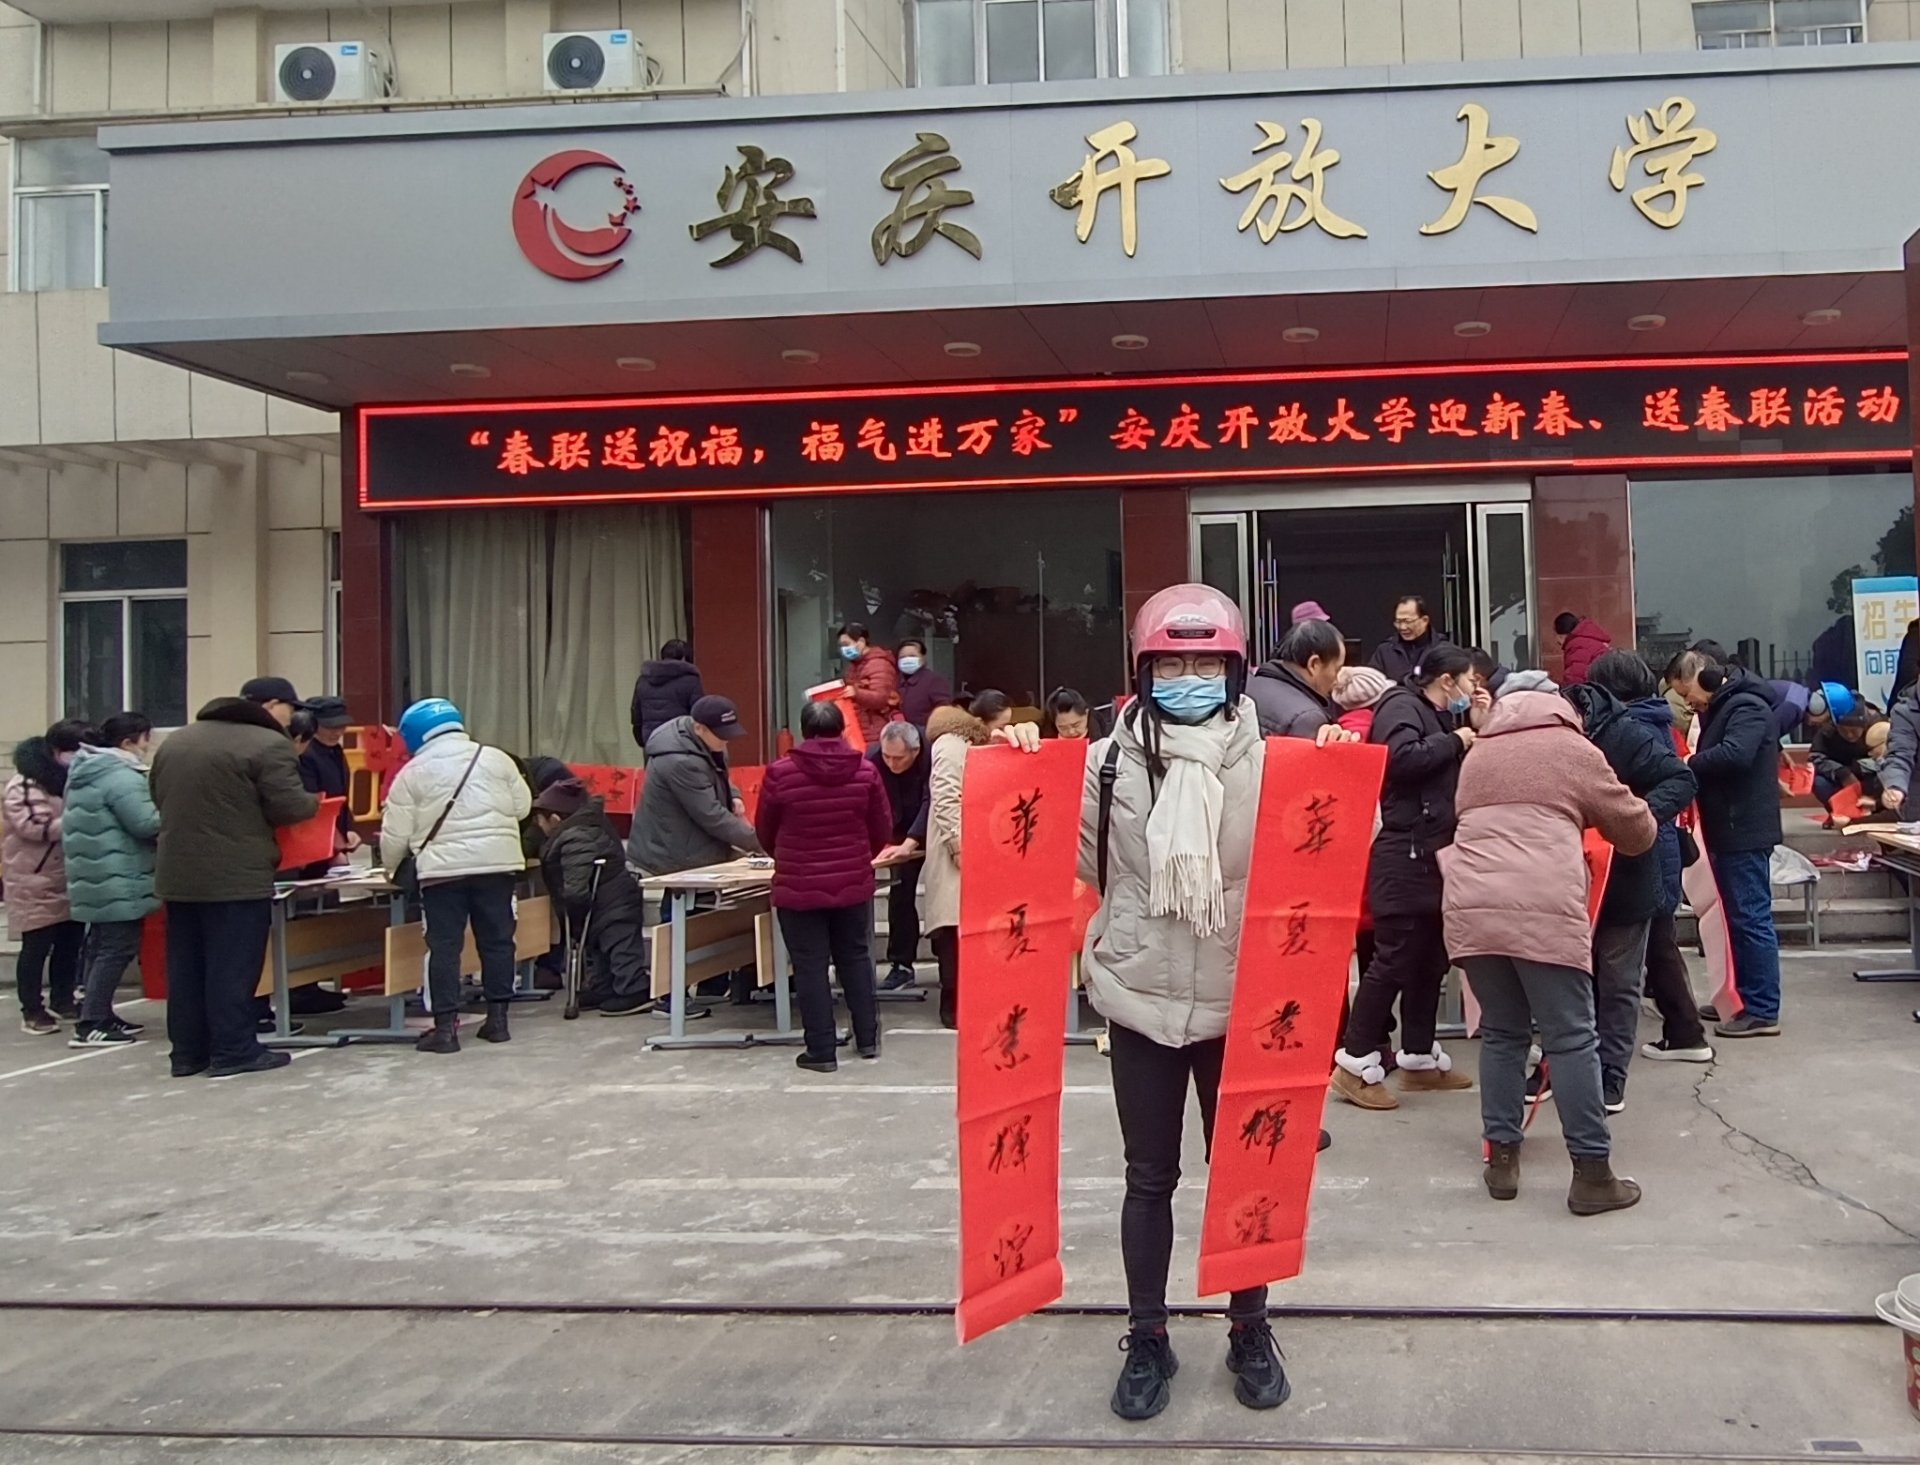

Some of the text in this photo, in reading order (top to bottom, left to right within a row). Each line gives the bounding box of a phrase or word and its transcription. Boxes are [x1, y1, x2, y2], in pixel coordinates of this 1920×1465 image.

[688, 95, 1718, 270] 安庆开放大学
